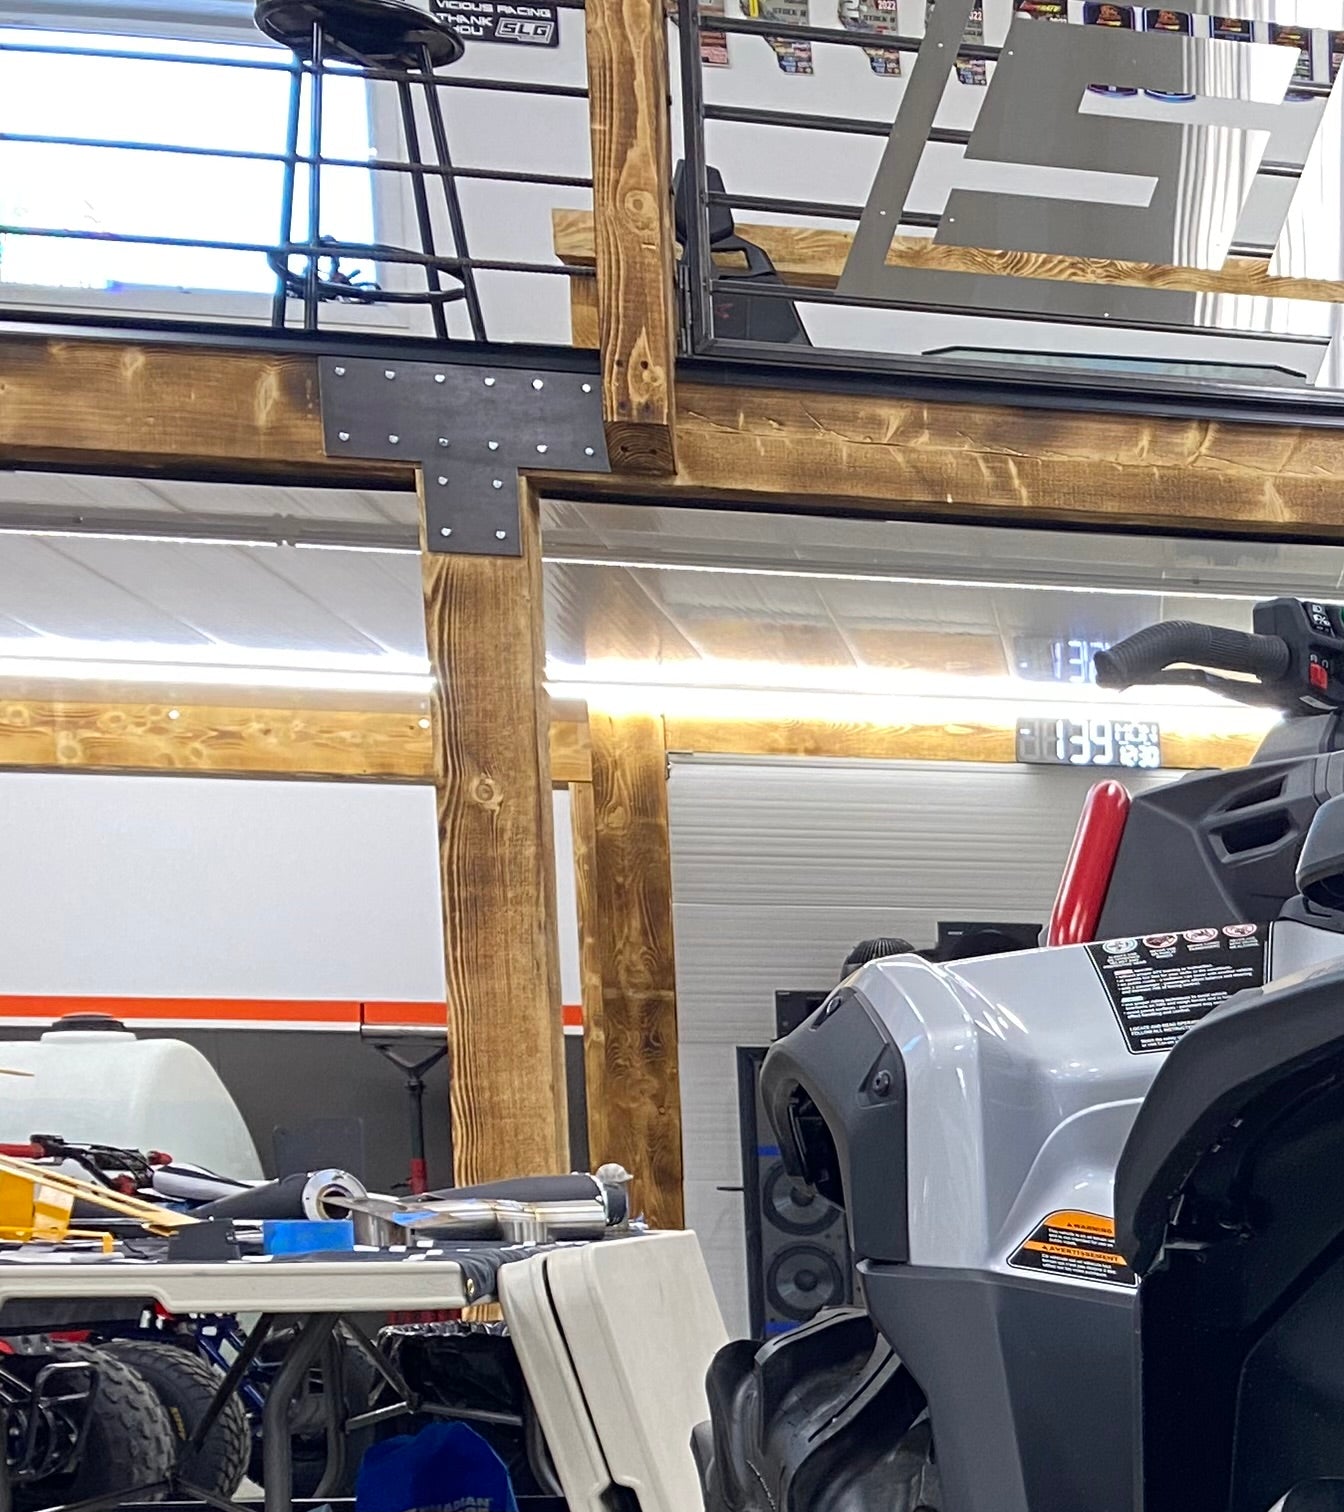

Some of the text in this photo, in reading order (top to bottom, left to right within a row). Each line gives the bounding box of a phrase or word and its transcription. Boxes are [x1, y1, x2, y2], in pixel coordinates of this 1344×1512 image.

[497, 4, 552, 18] RACING
[436, 12, 493, 26] THANK
[500, 21, 551, 36] SLG
